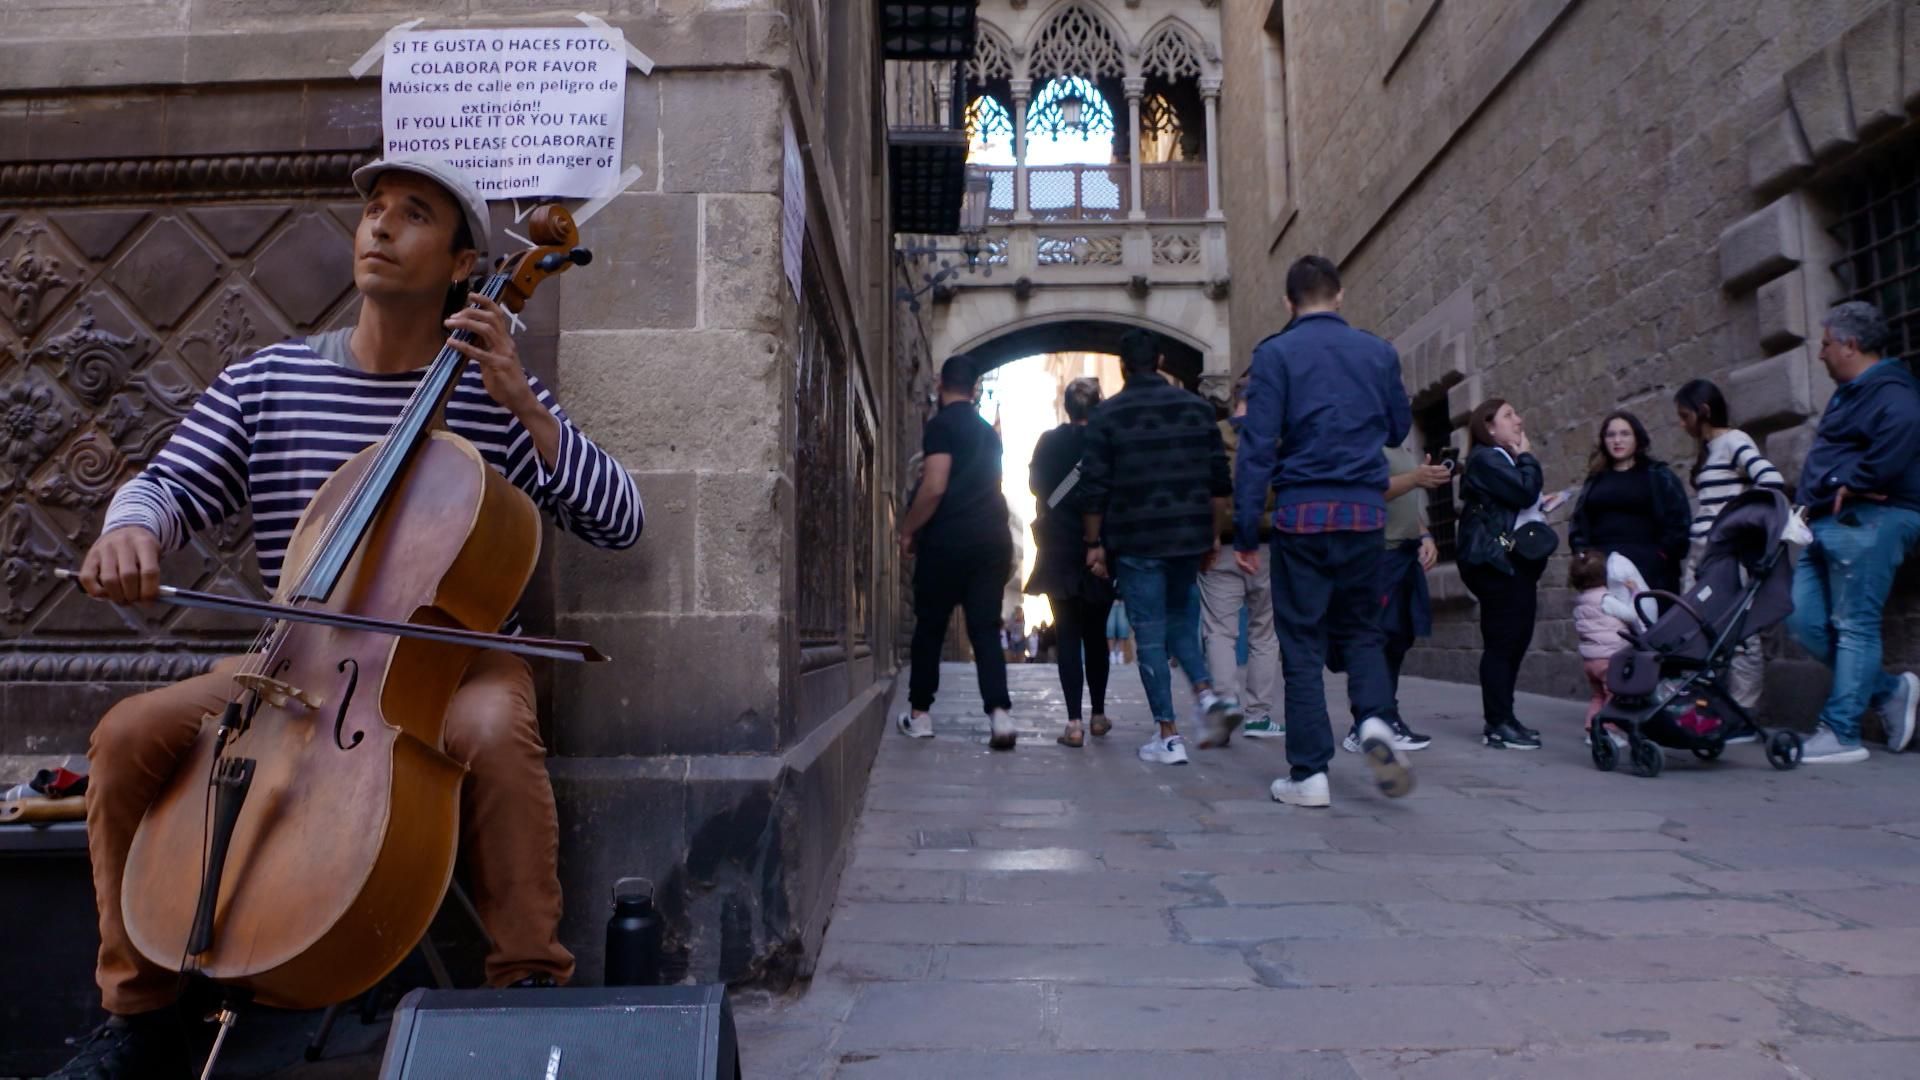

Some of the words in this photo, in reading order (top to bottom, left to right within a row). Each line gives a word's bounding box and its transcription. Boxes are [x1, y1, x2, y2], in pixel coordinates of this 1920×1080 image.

[392, 41, 406, 54] SI
[411, 41, 429, 53] TE
[434, 39, 487, 52] GUSTA
[492, 39, 504, 52] O
[509, 39, 561, 51] HACES
[565, 39, 616, 52] FOTO
[411, 61, 500, 75] COLABORA
[505, 61, 538, 73] POR
[543, 61, 598, 72] FAVOR
[388, 81, 450, 94] Músicxs
[454, 80, 473, 92] de
[477, 79, 512, 93] calle
[516, 81, 535, 91] en
[540, 79, 594, 94] peligro
[599, 79, 618, 92] de
[461, 100, 541, 114] extinción!!
[396, 117, 409, 130] IF
[413, 116, 445, 129] YOU
[451, 115, 483, 128] LIKE
[488, 115, 502, 128] IT
[505, 114, 526, 126] OR
[530, 113, 564, 126] YOU
[569, 113, 609, 126] TAKE
[389, 138, 450, 152] PHOTOS
[455, 137, 508, 150] PLEASE
[511, 135, 616, 149] COLABORATE
[445, 155, 514, 169] usicians
[518, 154, 532, 166] in
[536, 153, 593, 169] danger
[596, 155, 614, 168] of
[473, 175, 540, 190] tinction!!
